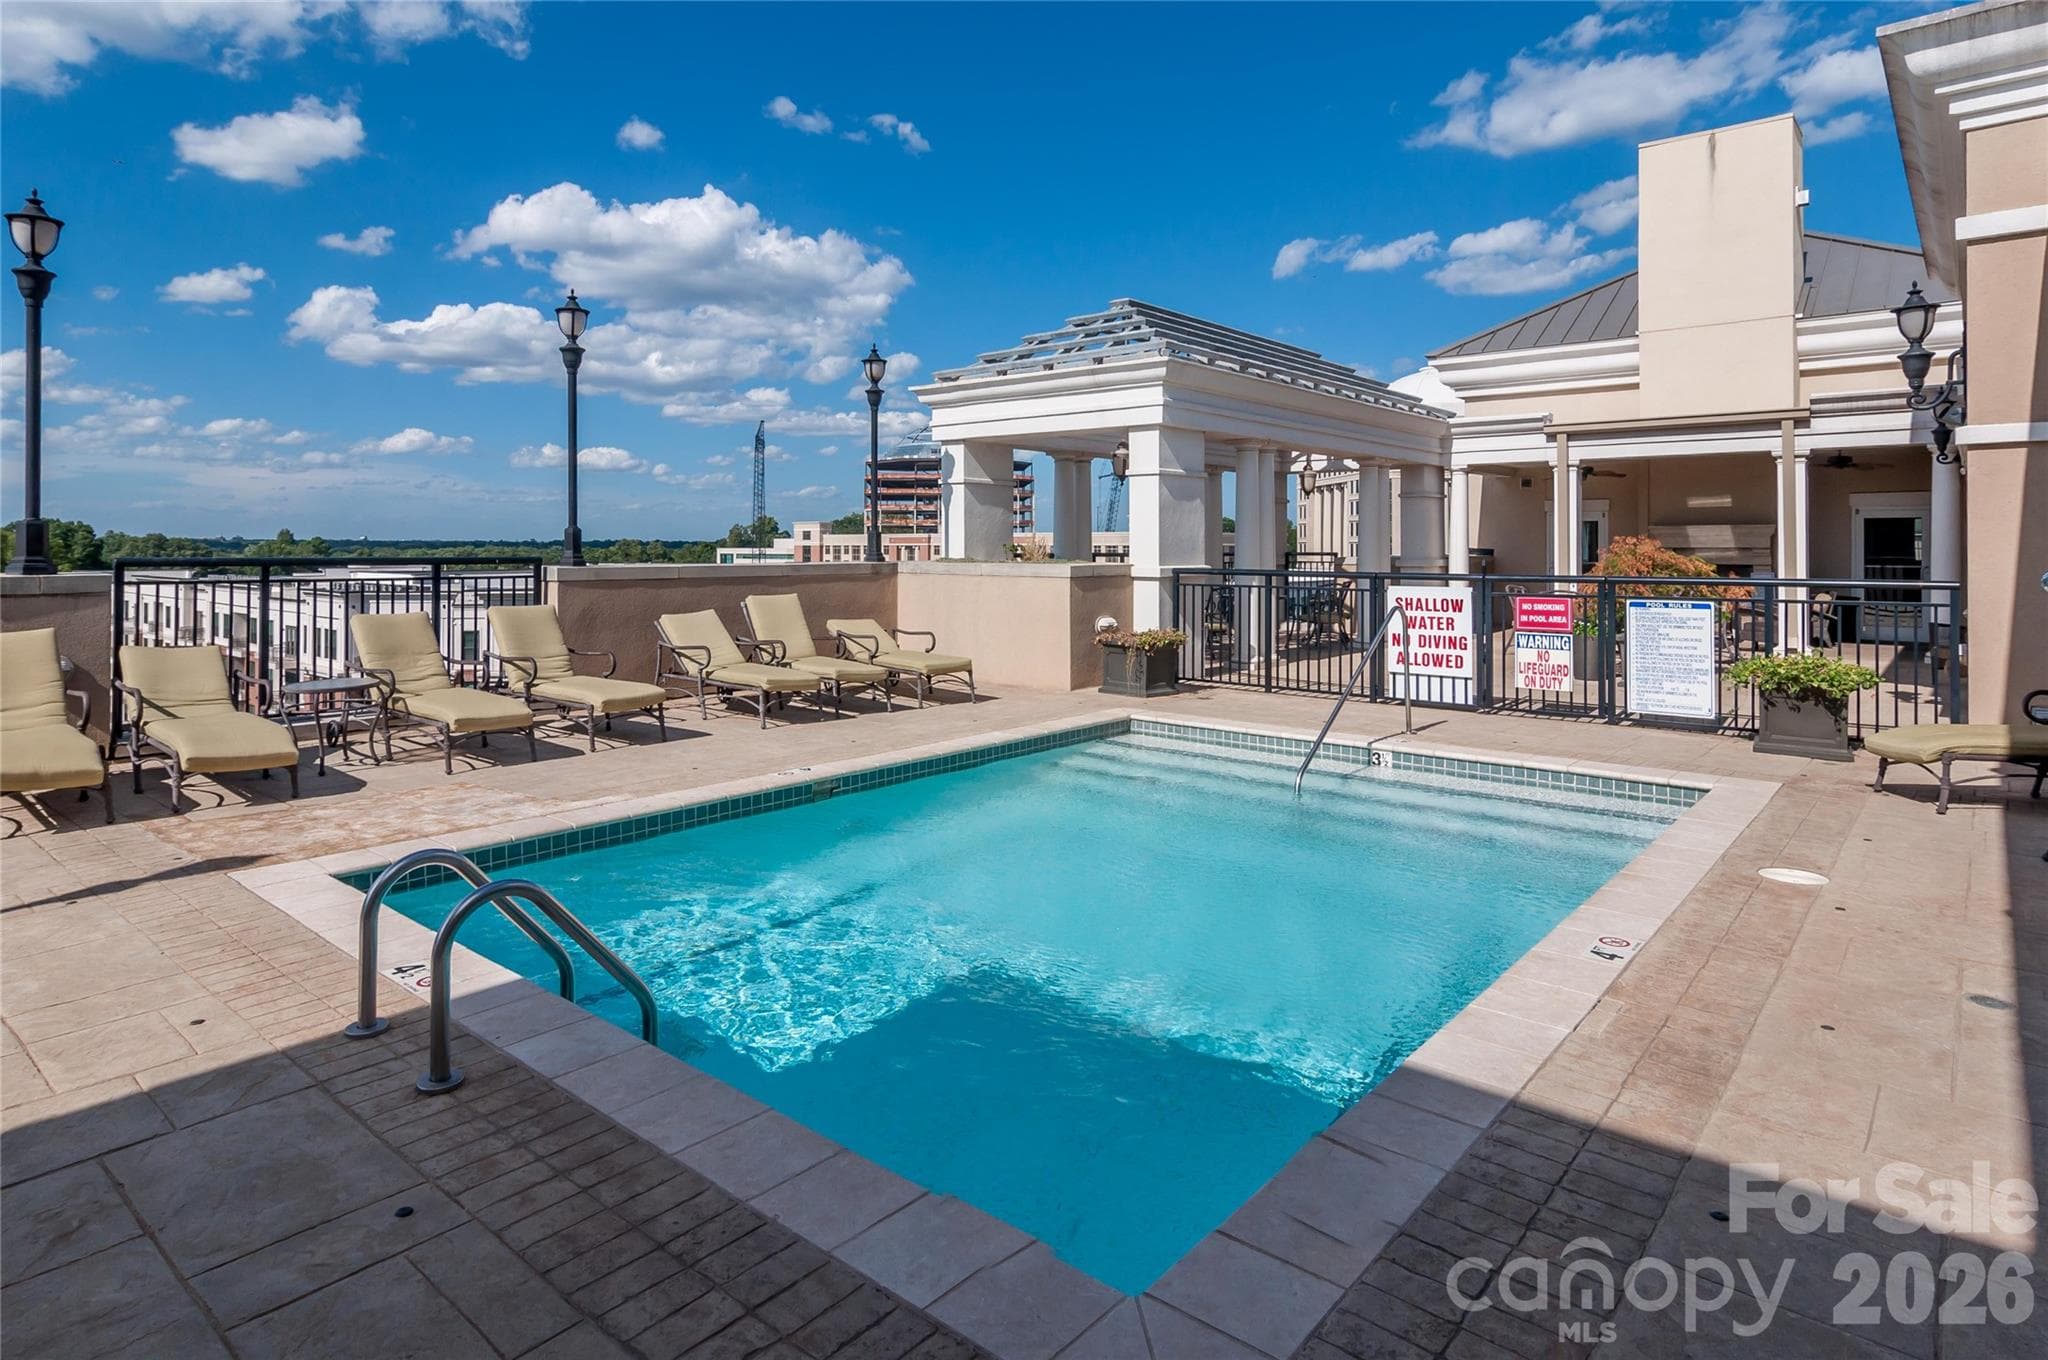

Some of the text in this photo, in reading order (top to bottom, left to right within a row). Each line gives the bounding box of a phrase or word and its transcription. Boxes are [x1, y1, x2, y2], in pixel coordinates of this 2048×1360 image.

[1395, 597, 1464, 613] SHALLOW
[1522, 603, 1565, 611] NO SMOKING
[1406, 615, 1455, 631] WATER
[1548, 616, 1567, 624] AREA
[1418, 634, 1468, 651] DIVING
[1518, 634, 1569, 650] WARNING
[1537, 650, 1550, 662] NO
[1518, 661, 1569, 677] LIFEGUARD
[1524, 675, 1563, 690] ON DUTY
